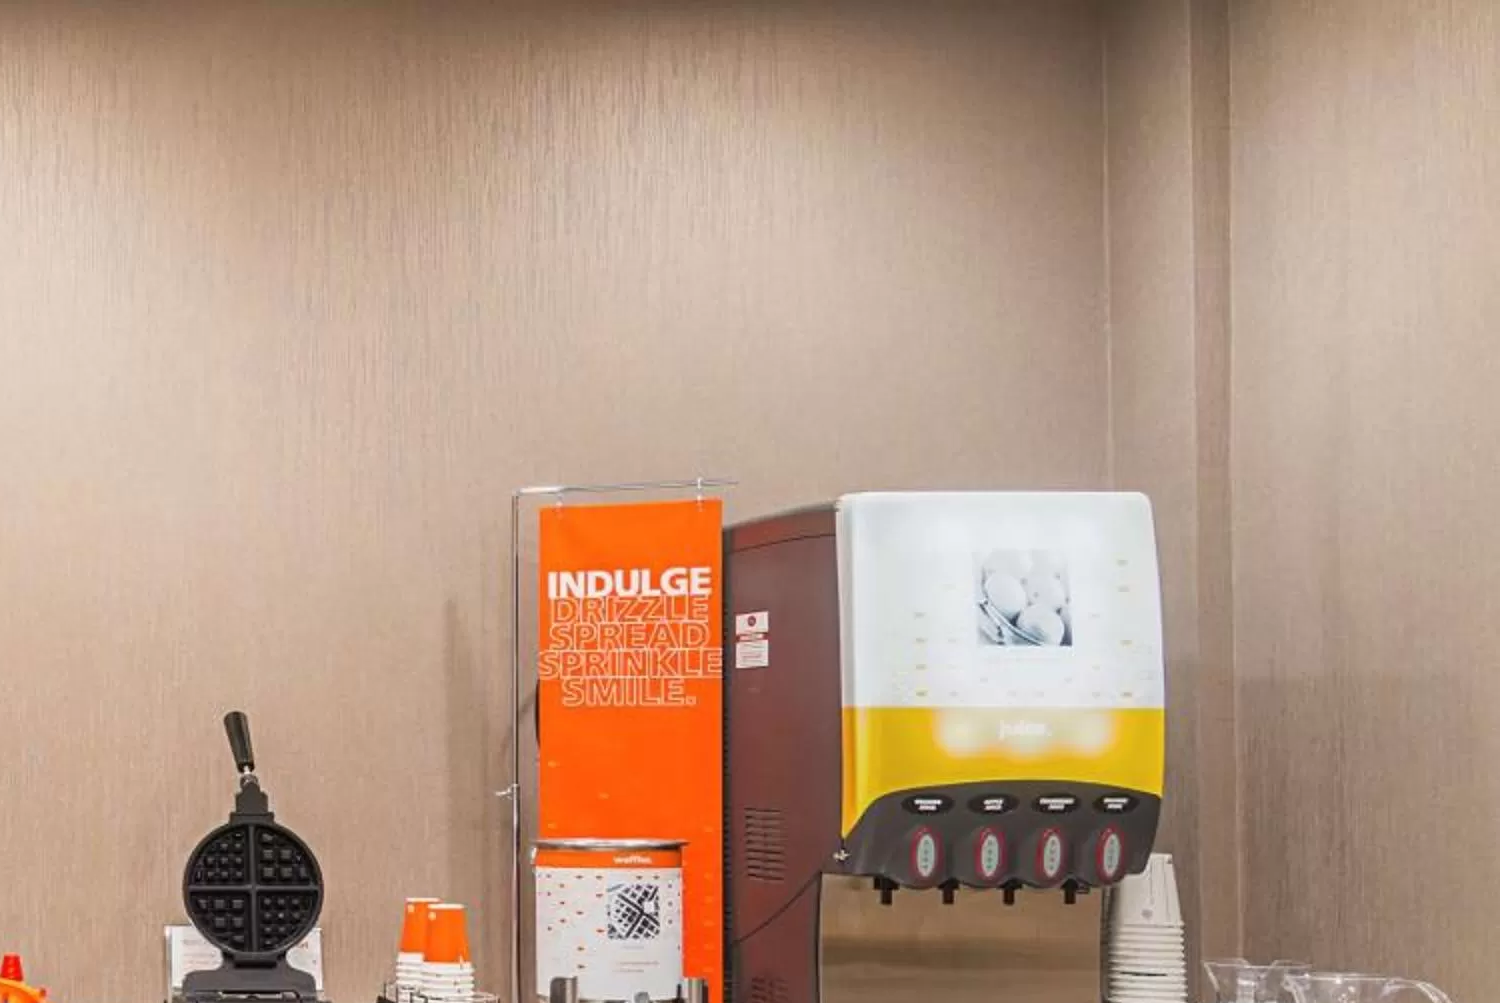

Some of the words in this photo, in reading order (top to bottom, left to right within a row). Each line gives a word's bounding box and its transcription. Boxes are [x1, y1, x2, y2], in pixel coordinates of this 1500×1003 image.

[548, 567, 713, 600] INDULGE
[553, 594, 709, 623] DRIZZLE
[550, 621, 712, 651] SPREAD
[539, 647, 723, 679] SPRINKLE
[562, 676, 697, 706] SMILE.
